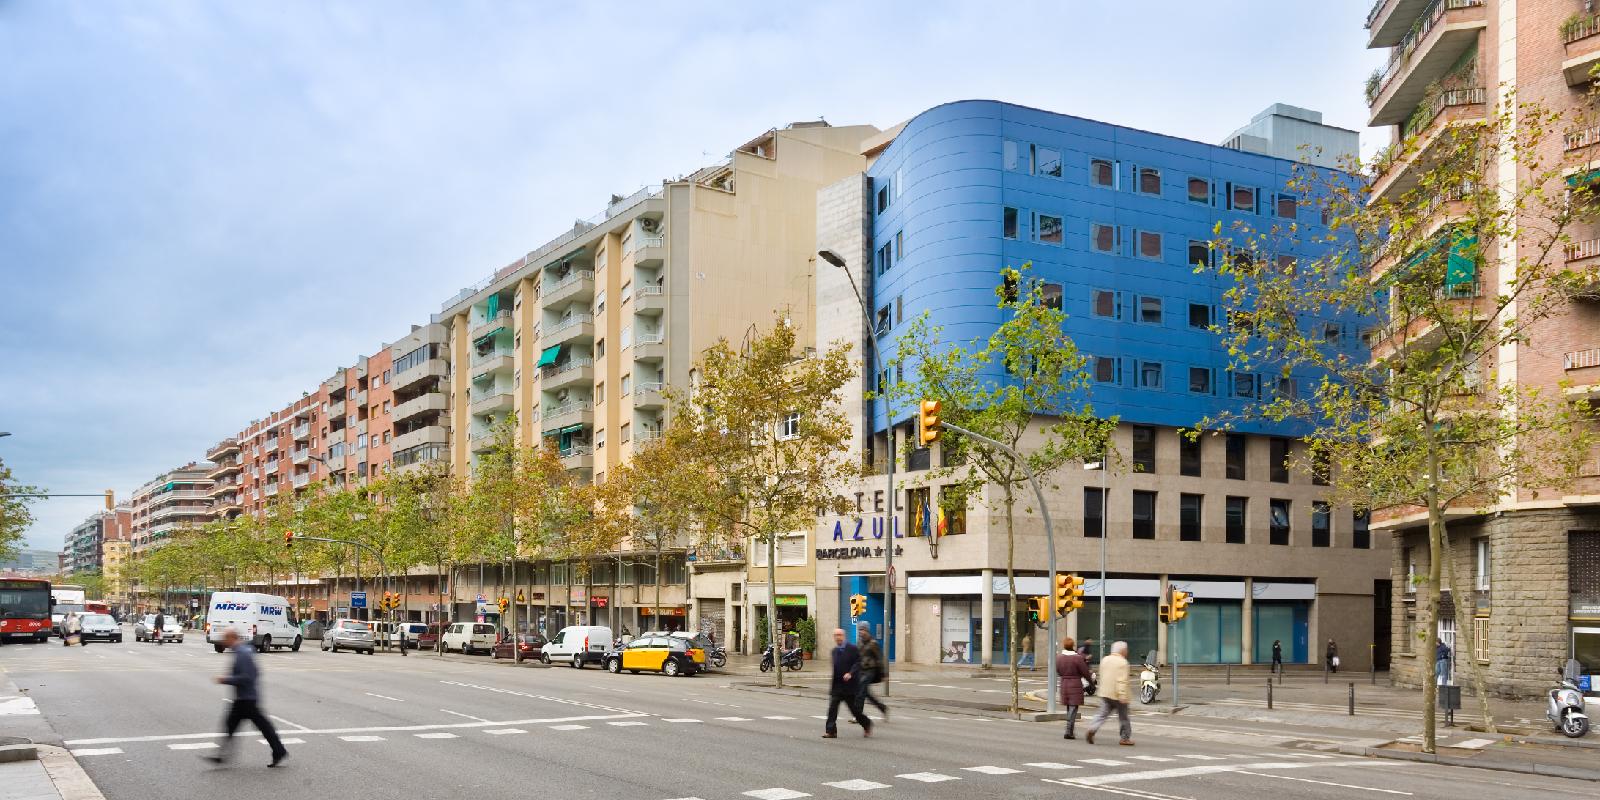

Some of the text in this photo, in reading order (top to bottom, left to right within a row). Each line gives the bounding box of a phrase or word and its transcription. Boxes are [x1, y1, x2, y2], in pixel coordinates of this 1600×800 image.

[833, 516, 904, 541] AZUL
[815, 547, 872, 560] BARCELONA
[215, 603, 249, 611] MRW
[261, 606, 283, 616] MRW
